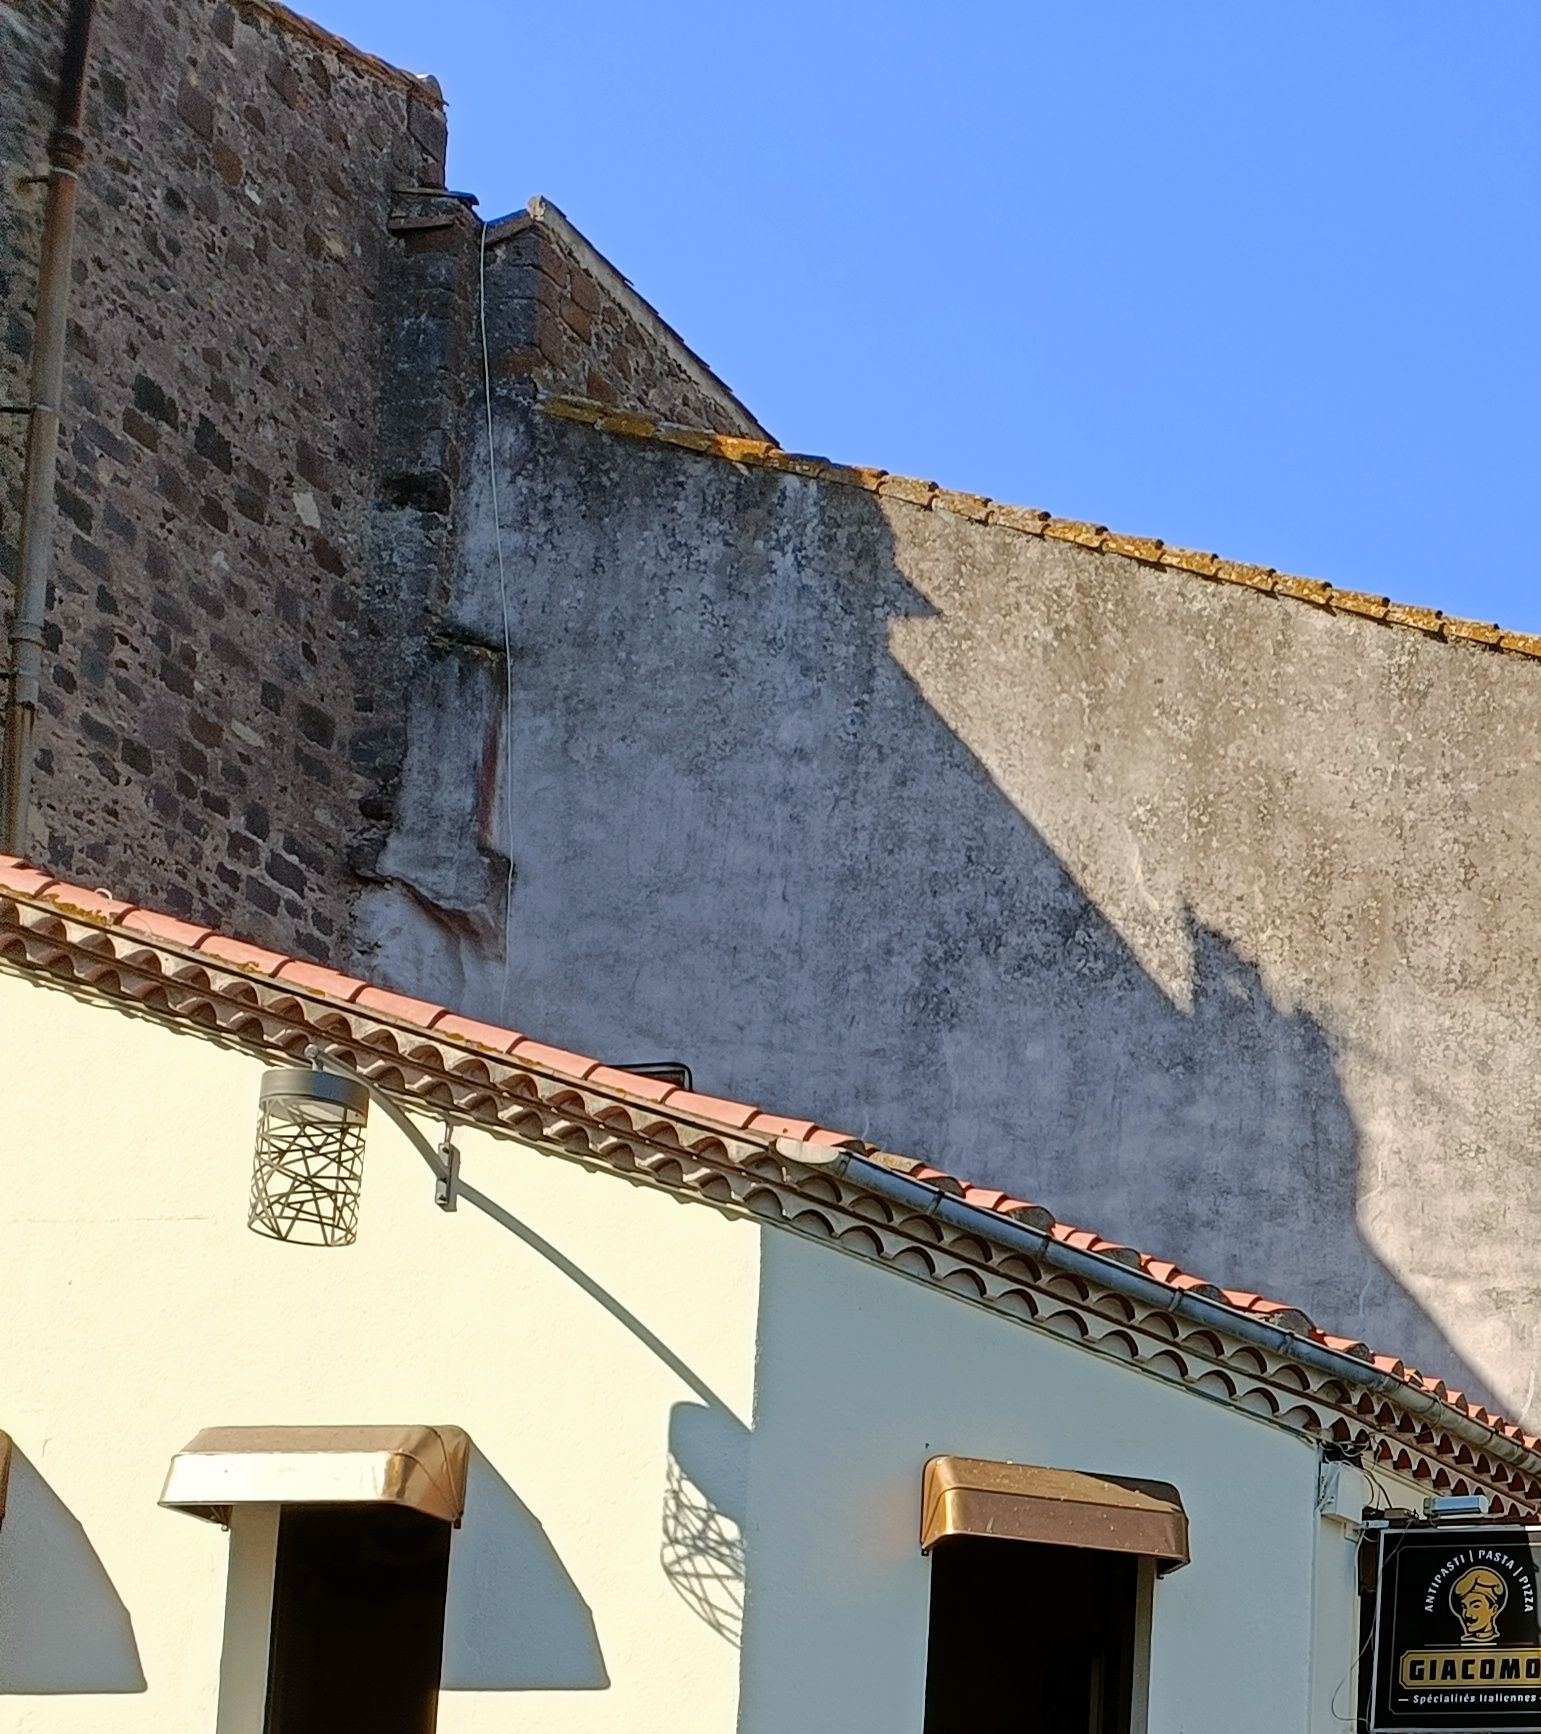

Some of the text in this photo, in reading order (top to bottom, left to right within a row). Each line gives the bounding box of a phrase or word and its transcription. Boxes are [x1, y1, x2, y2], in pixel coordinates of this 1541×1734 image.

[1424, 1549, 1534, 1613] ANTIPASTI PASTA PIZZA
[1409, 1658, 1541, 1681] GIACOMO
[1413, 1692, 1537, 1705] Spécialités Italiennes
